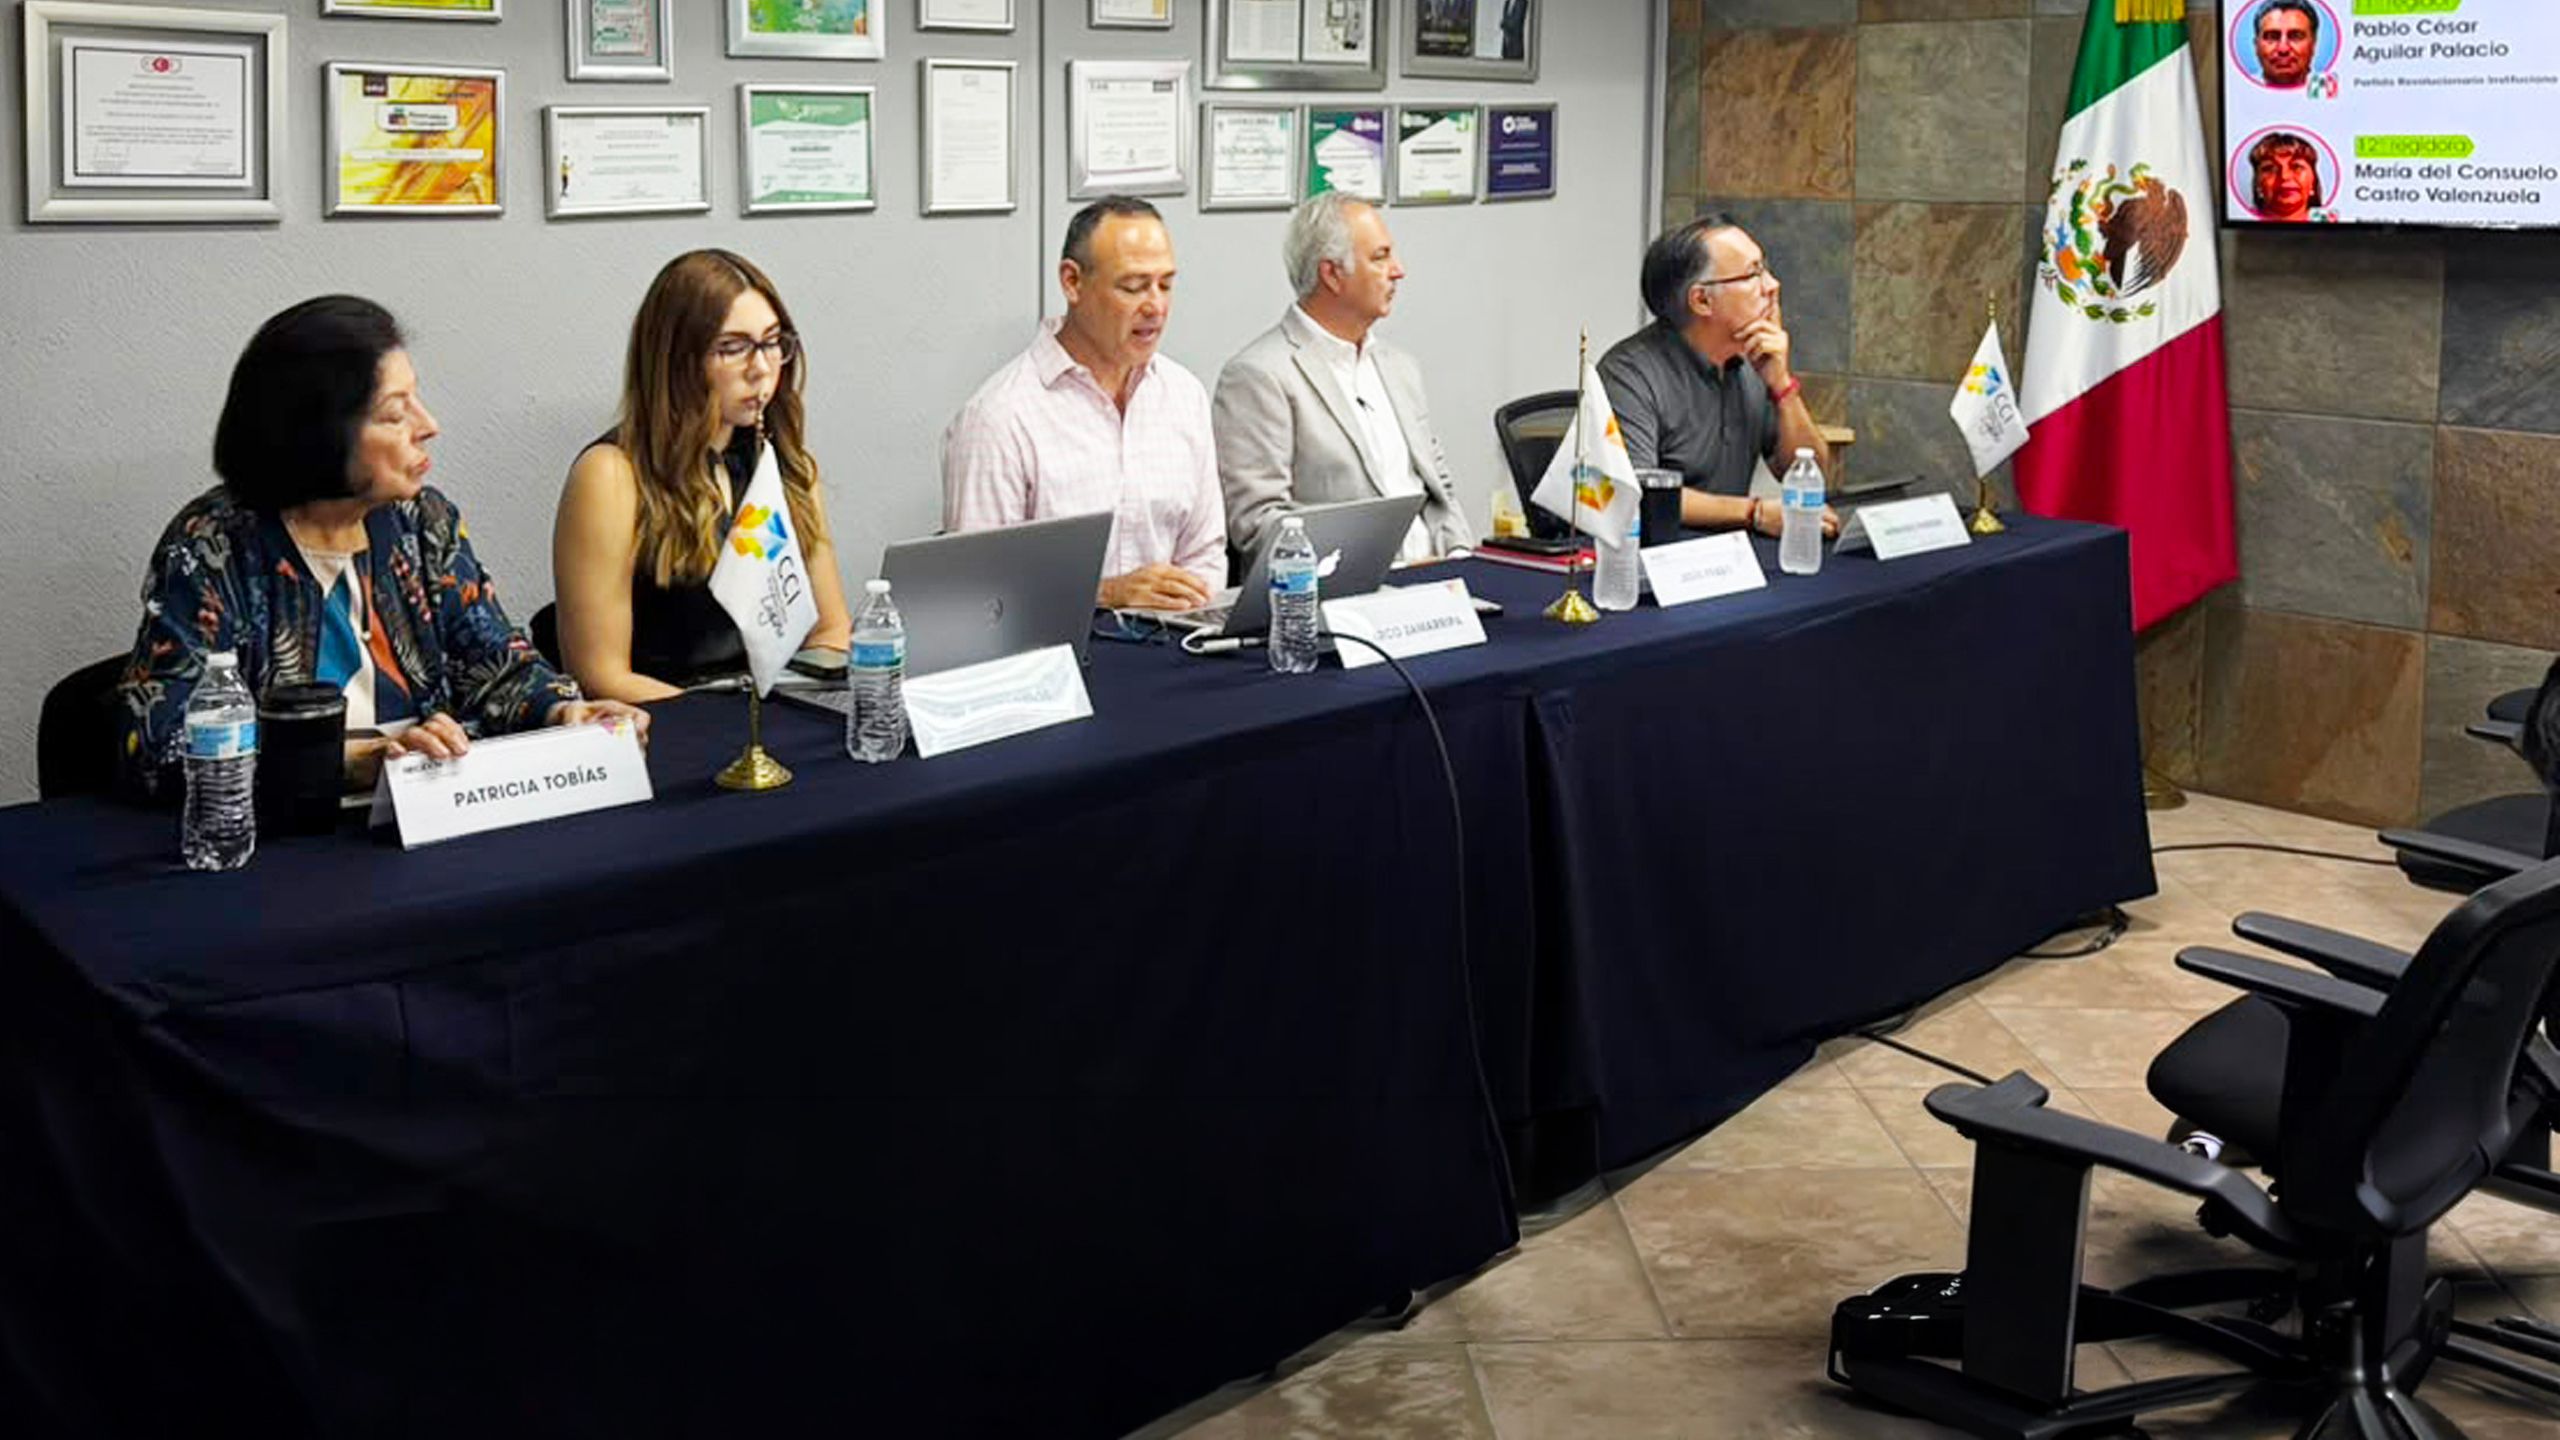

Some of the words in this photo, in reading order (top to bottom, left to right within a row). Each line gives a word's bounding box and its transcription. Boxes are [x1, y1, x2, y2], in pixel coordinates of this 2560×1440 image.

[2353, 21, 2411, 37] Pablo
[2416, 18, 2479, 35] César
[2353, 44, 2425, 63] Aguilar
[2429, 41, 2510, 58] Palacio
[2390, 137, 2467, 156] regidora
[2355, 164, 2412, 179] María
[2417, 164, 2451, 179] del
[2457, 164, 2558, 180] Consuelo
[2355, 186, 2421, 201] Castro
[2426, 187, 2541, 203] Valenzuela
[1994, 392, 2014, 424] CCI
[777, 555, 801, 605] CCI
[453, 778, 540, 807] PATRICIA
[543, 765, 608, 791] TOBÍAS
